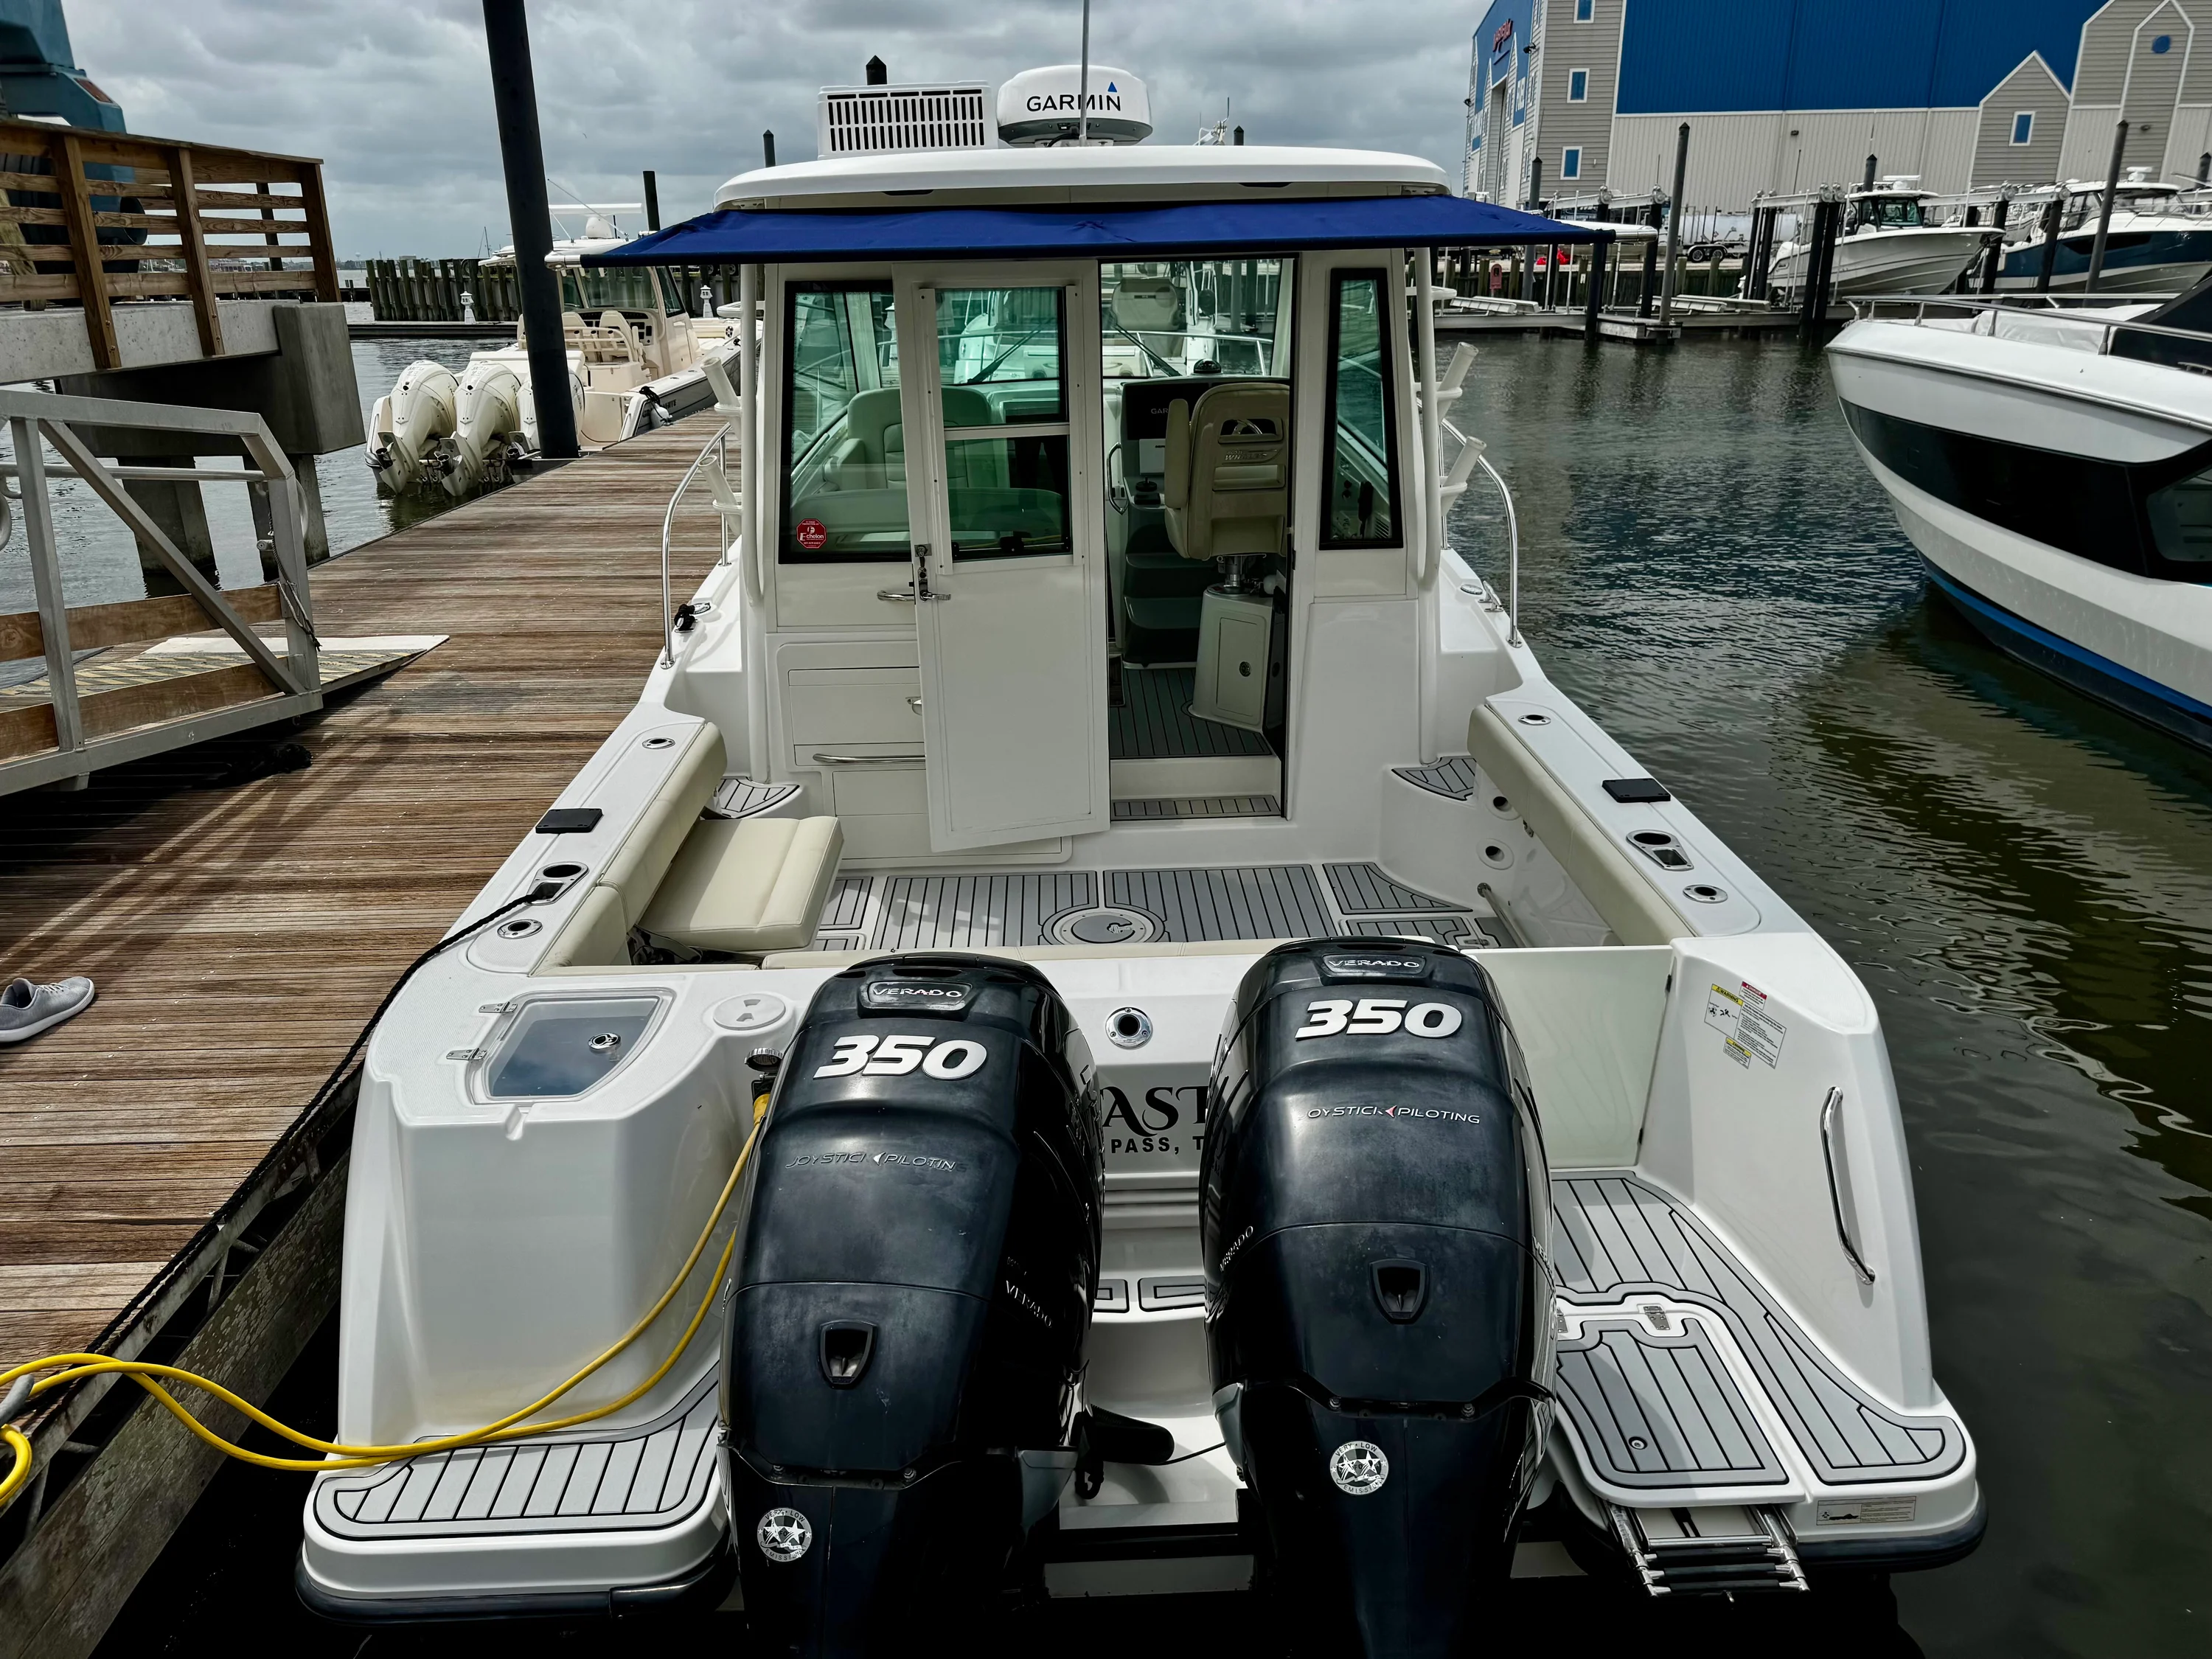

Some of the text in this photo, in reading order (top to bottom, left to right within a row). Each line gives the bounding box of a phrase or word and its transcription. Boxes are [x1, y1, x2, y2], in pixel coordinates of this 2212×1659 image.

[1026, 94, 1121, 111] GARMIN
[800, 532, 824, 540] Echelon
[1329, 959, 1420, 968] VERADO
[873, 987, 962, 998] VERADO
[1720, 988, 1739, 1003] WARNING
[1295, 999, 1462, 1041] 350
[813, 1034, 987, 1080] 350
[1307, 1106, 1480, 1124] OYSTICK PILOTING
[1111, 1135, 1205, 1155] PASS, T
[1220, 1225, 1253, 1273] VERADO
[1006, 1280, 1053, 1328] VERADO
[1335, 1442, 1377, 1456] VERY LOW
[765, 1509, 805, 1522] VERY LOW
